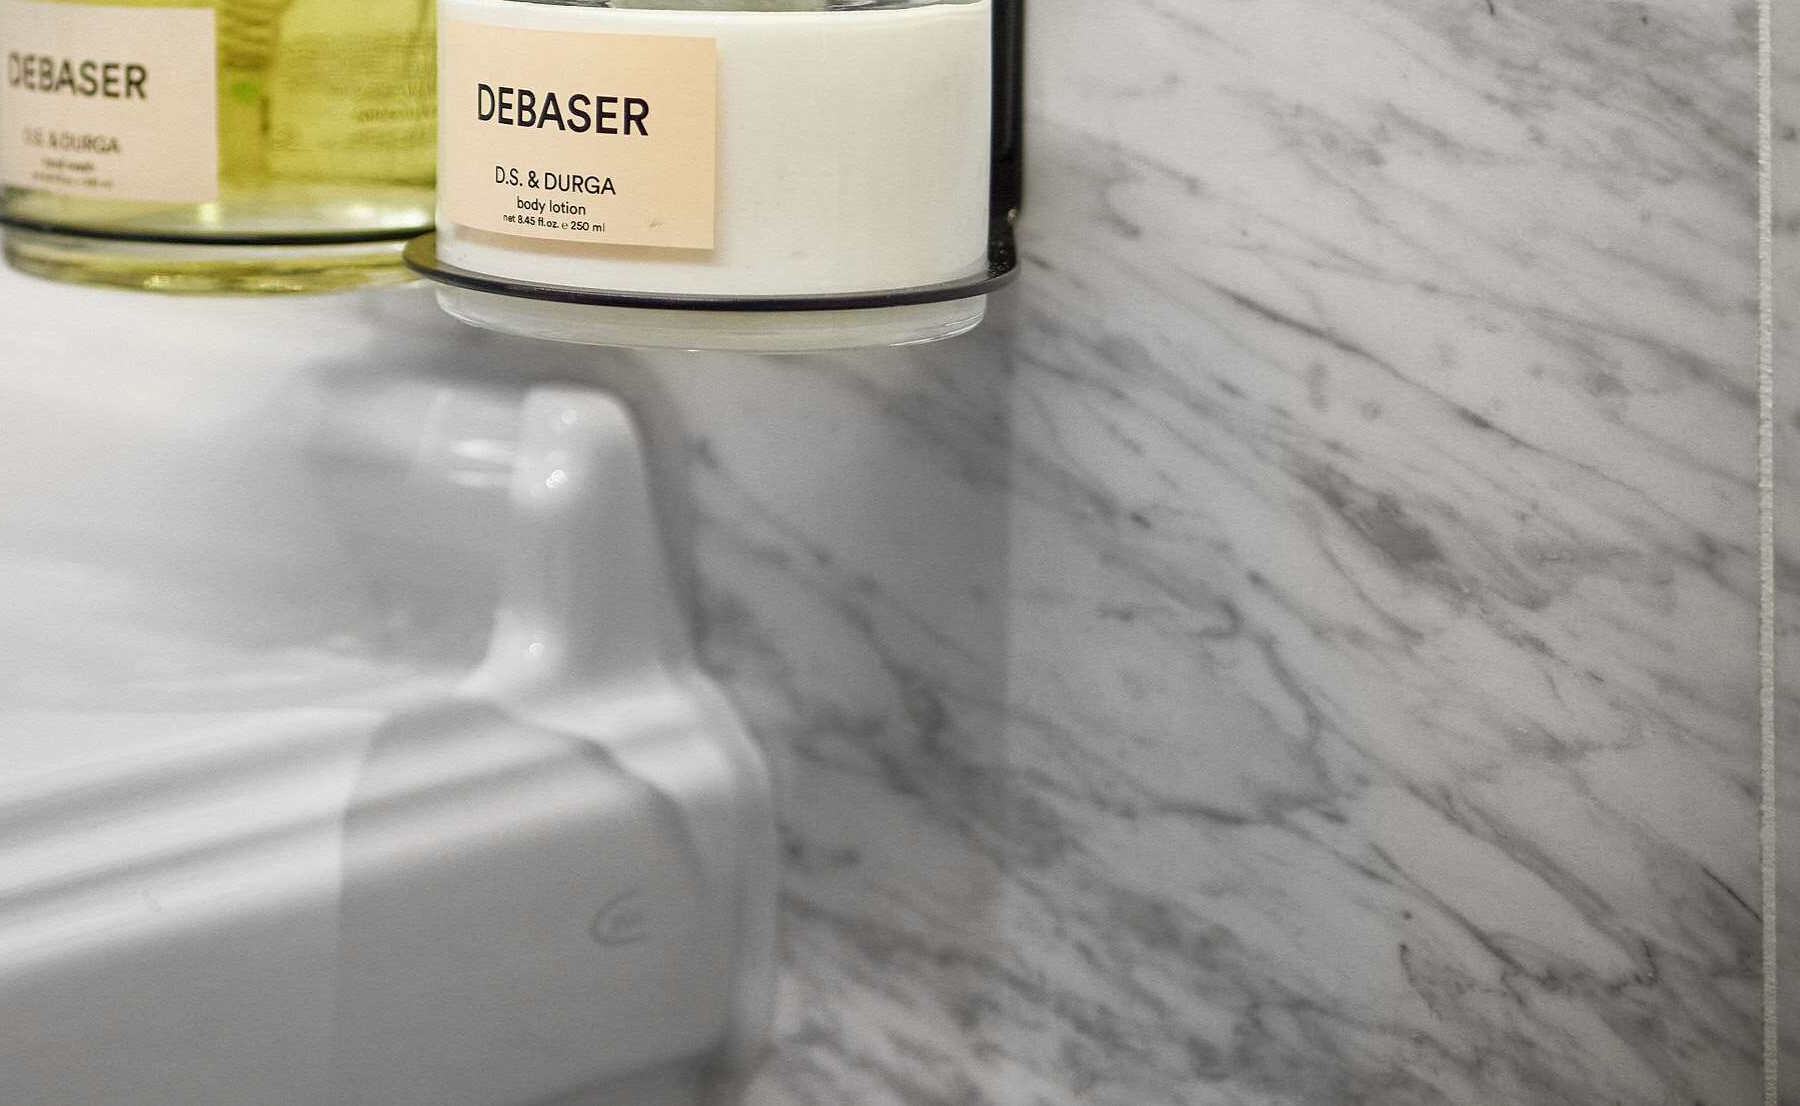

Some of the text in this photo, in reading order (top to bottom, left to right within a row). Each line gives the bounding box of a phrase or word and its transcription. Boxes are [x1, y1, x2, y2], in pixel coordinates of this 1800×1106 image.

[8, 51, 148, 100] DEBASER
[477, 83, 649, 136] DEBASER
[495, 165, 616, 195] D.S. & DURGA
[516, 195, 586, 215] body lotion
[503, 214, 516, 223] net
[517, 214, 536, 226] 8.45
[570, 220, 590, 231] 250
[592, 222, 606, 233] ml
